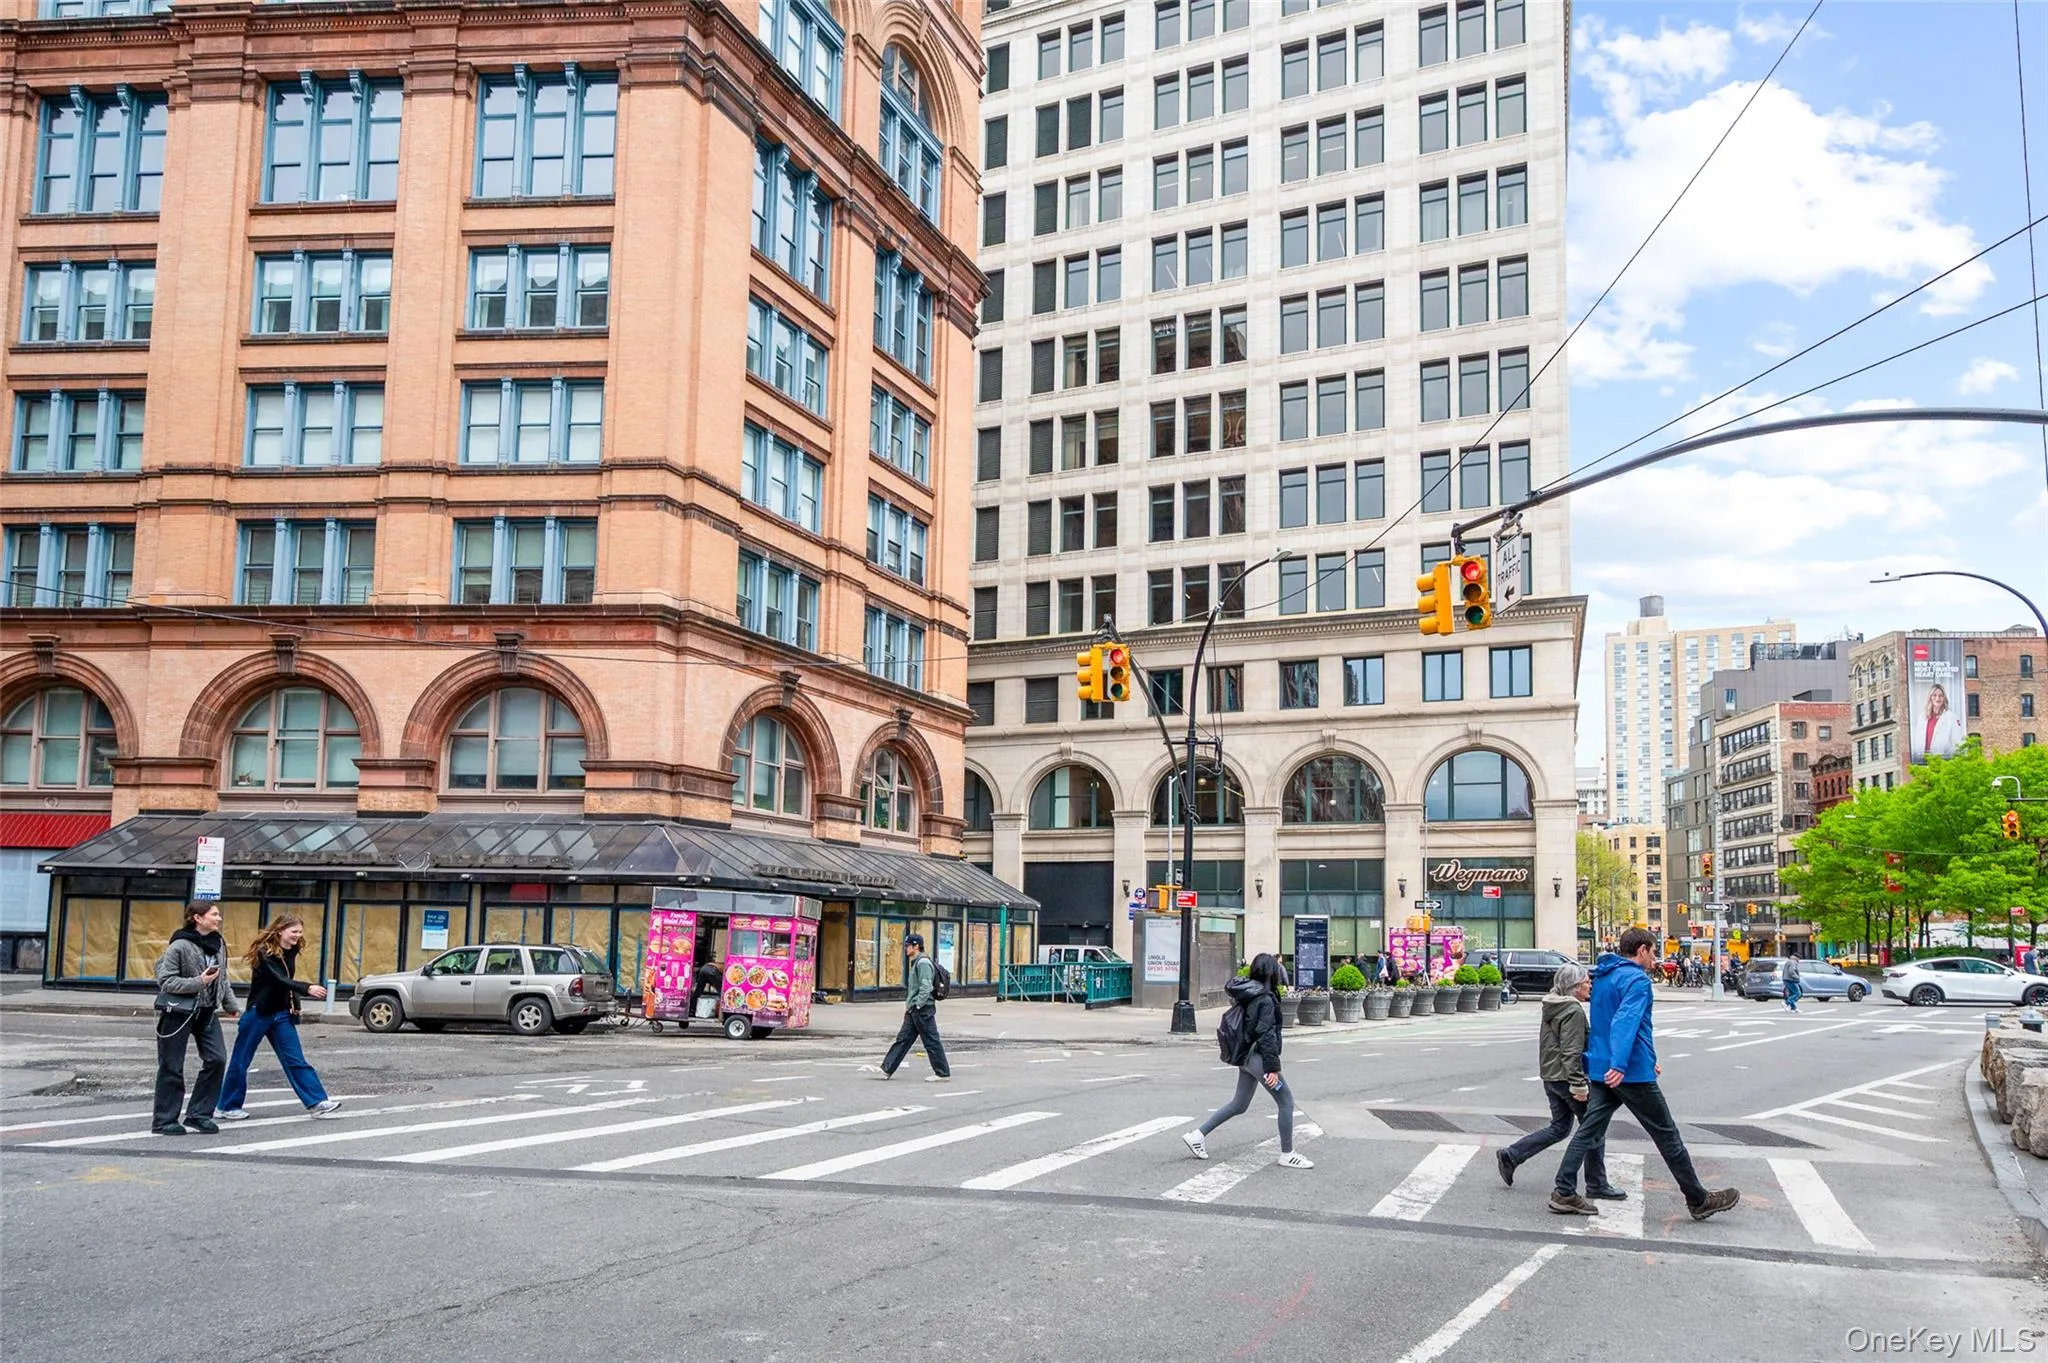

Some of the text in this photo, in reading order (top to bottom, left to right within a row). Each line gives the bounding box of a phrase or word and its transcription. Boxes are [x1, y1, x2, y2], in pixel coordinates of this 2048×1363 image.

[1503, 544, 1517, 565] ALL
[1498, 560, 1520, 585] TRAFFIC
[1430, 859, 1528, 891] Wegmans
[670, 912, 688, 920] Family
